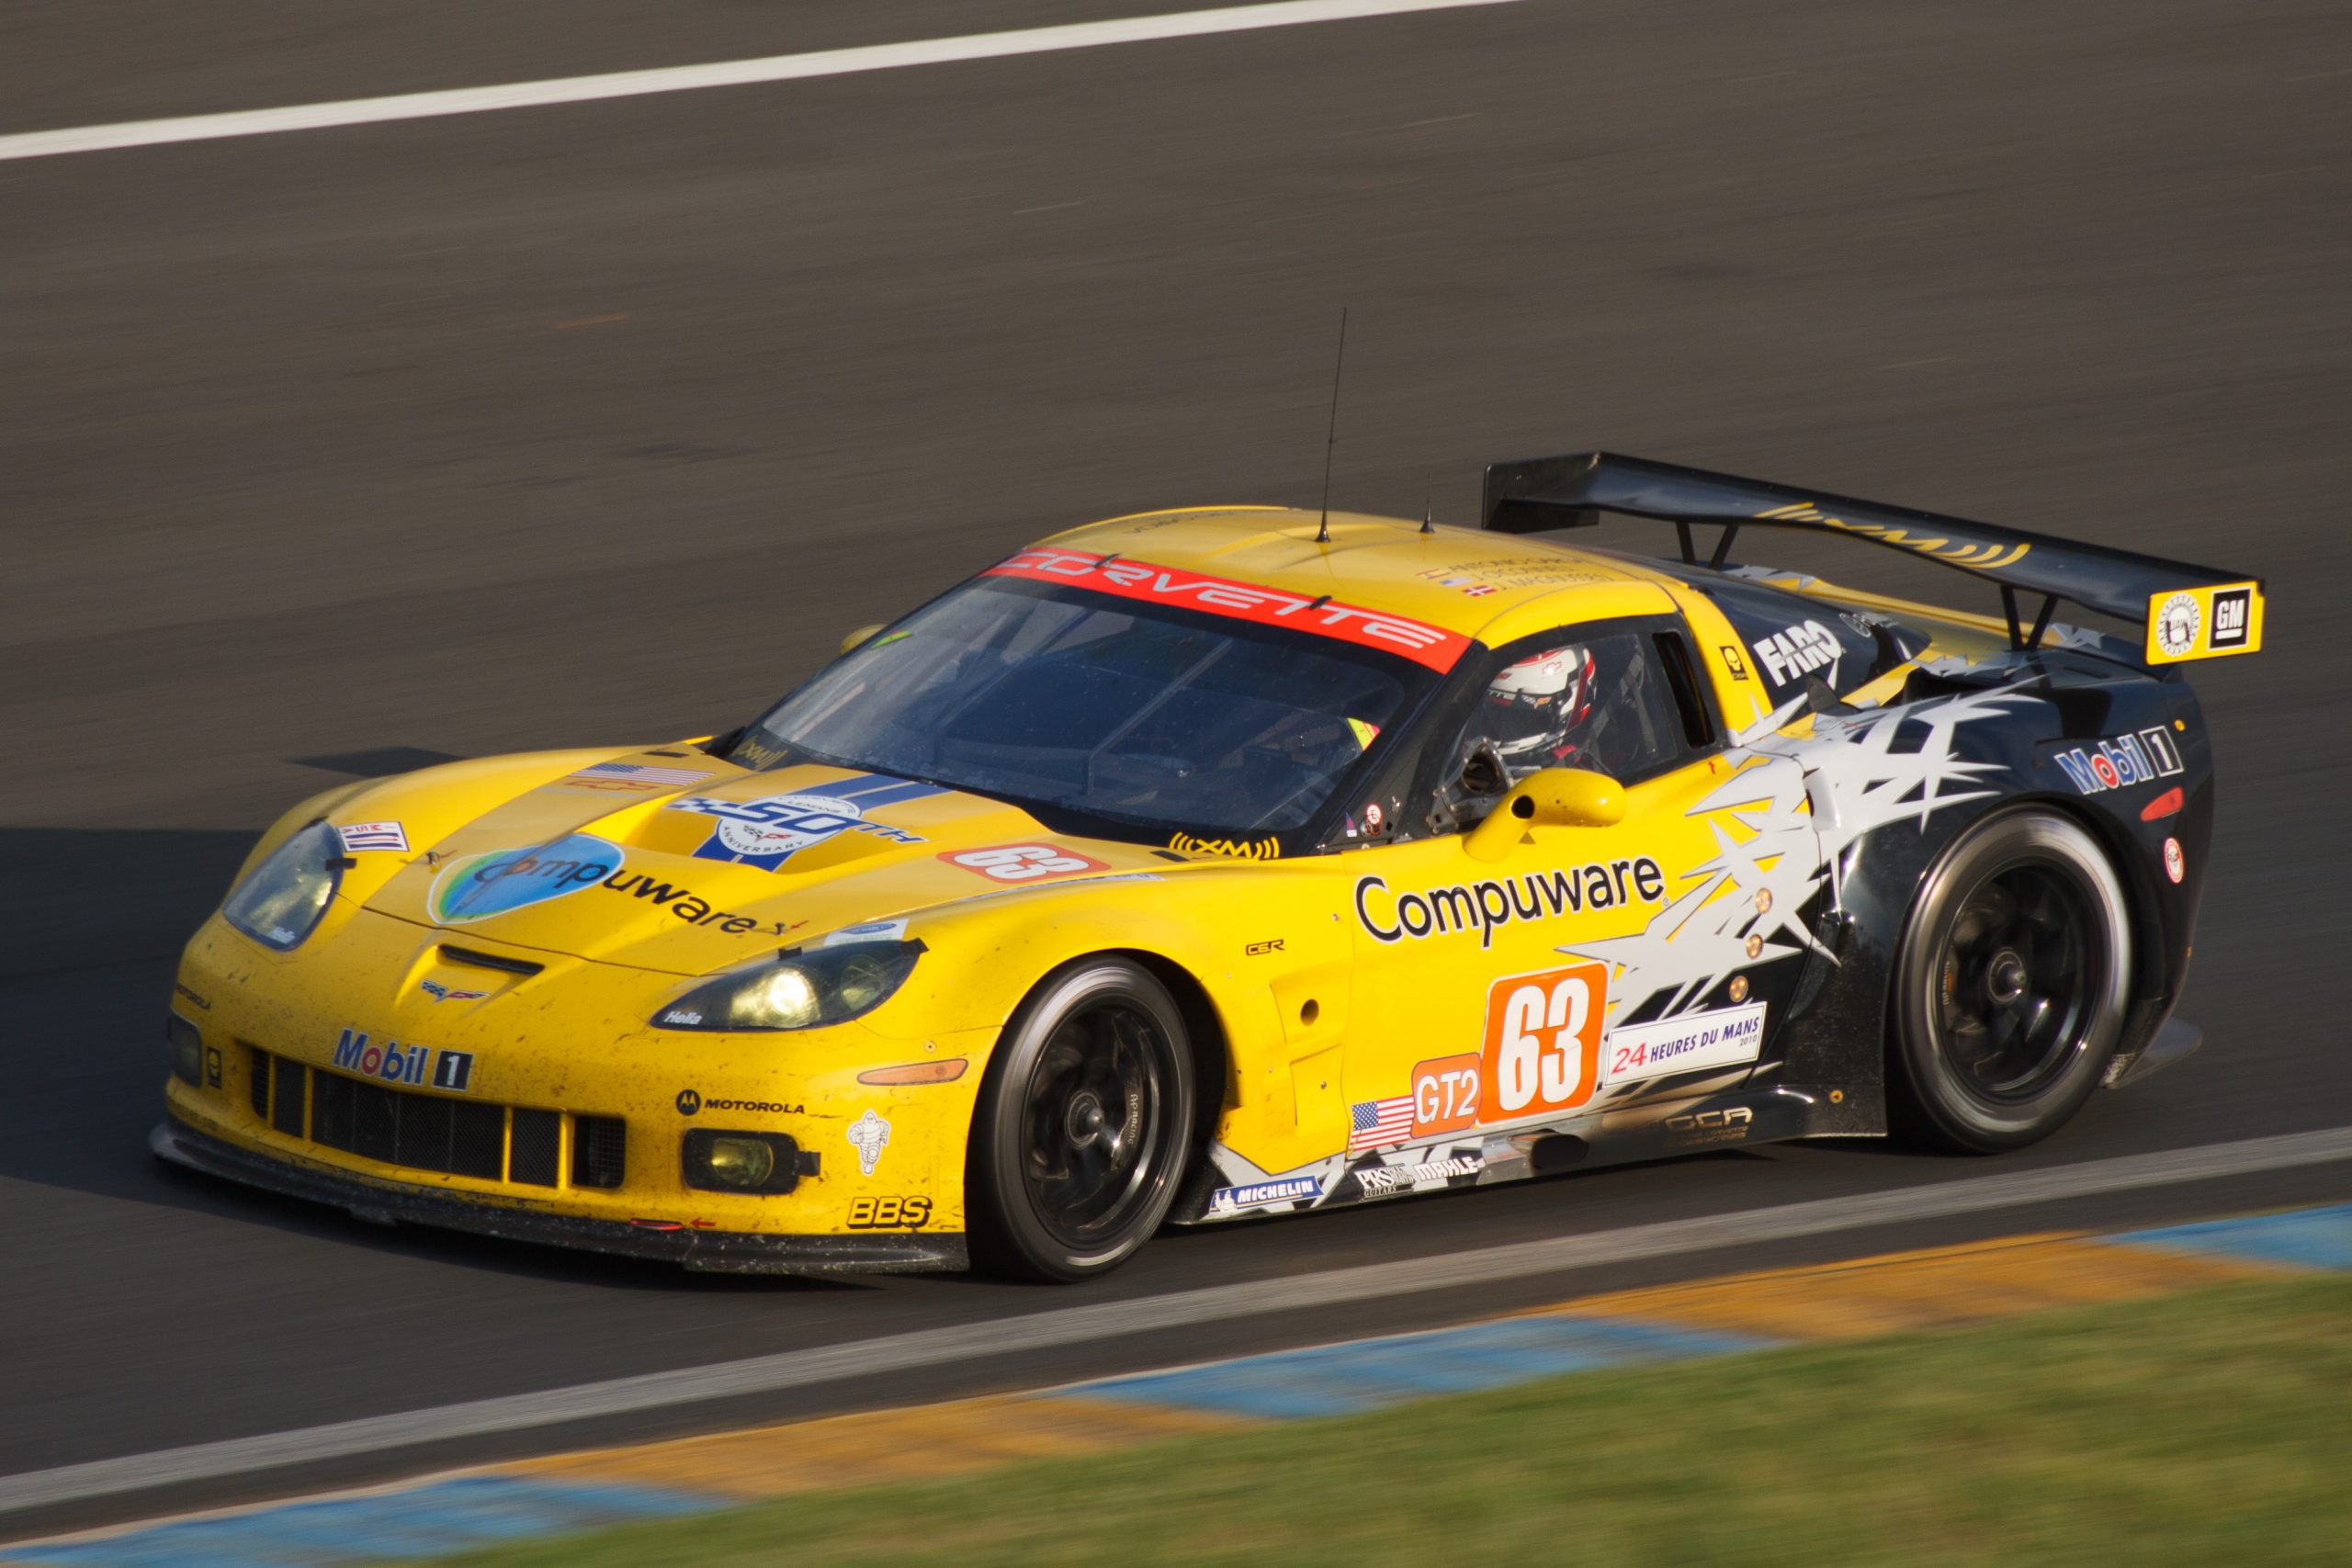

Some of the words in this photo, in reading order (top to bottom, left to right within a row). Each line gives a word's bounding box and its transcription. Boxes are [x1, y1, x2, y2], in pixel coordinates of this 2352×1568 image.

[996, 552, 1448, 649] CORVETTE
[2216, 599, 2245, 630] GM
[1753, 620, 1842, 687] FARO
[2053, 734, 2154, 795] Mobil
[723, 825, 805, 853] ANNIVERSARY
[954, 845, 1091, 880] 63
[473, 852, 758, 935] Compuware
[1355, 855, 1665, 948] Compuware
[663, 1010, 703, 1025] Hella
[333, 1027, 430, 1086] Mobil
[1498, 977, 1591, 1111] 63
[1611, 1043, 1647, 1076] 24
[1650, 1034, 1697, 1063] HEURES
[1701, 1028, 1718, 1047] DU
[1722, 1016, 1759, 1042] MANS
[1739, 1035, 1758, 1047] 2010
[704, 1099, 805, 1114] MOTOROLA
[1415, 1068, 1479, 1124] GT2
[1354, 1168, 1396, 1190] PRS
[1414, 1156, 1478, 1181] MAHLE
[1237, 1179, 1315, 1203] MICHELIN
[1363, 1186, 1397, 1198] GUITARS
[847, 1196, 933, 1228] BBS
